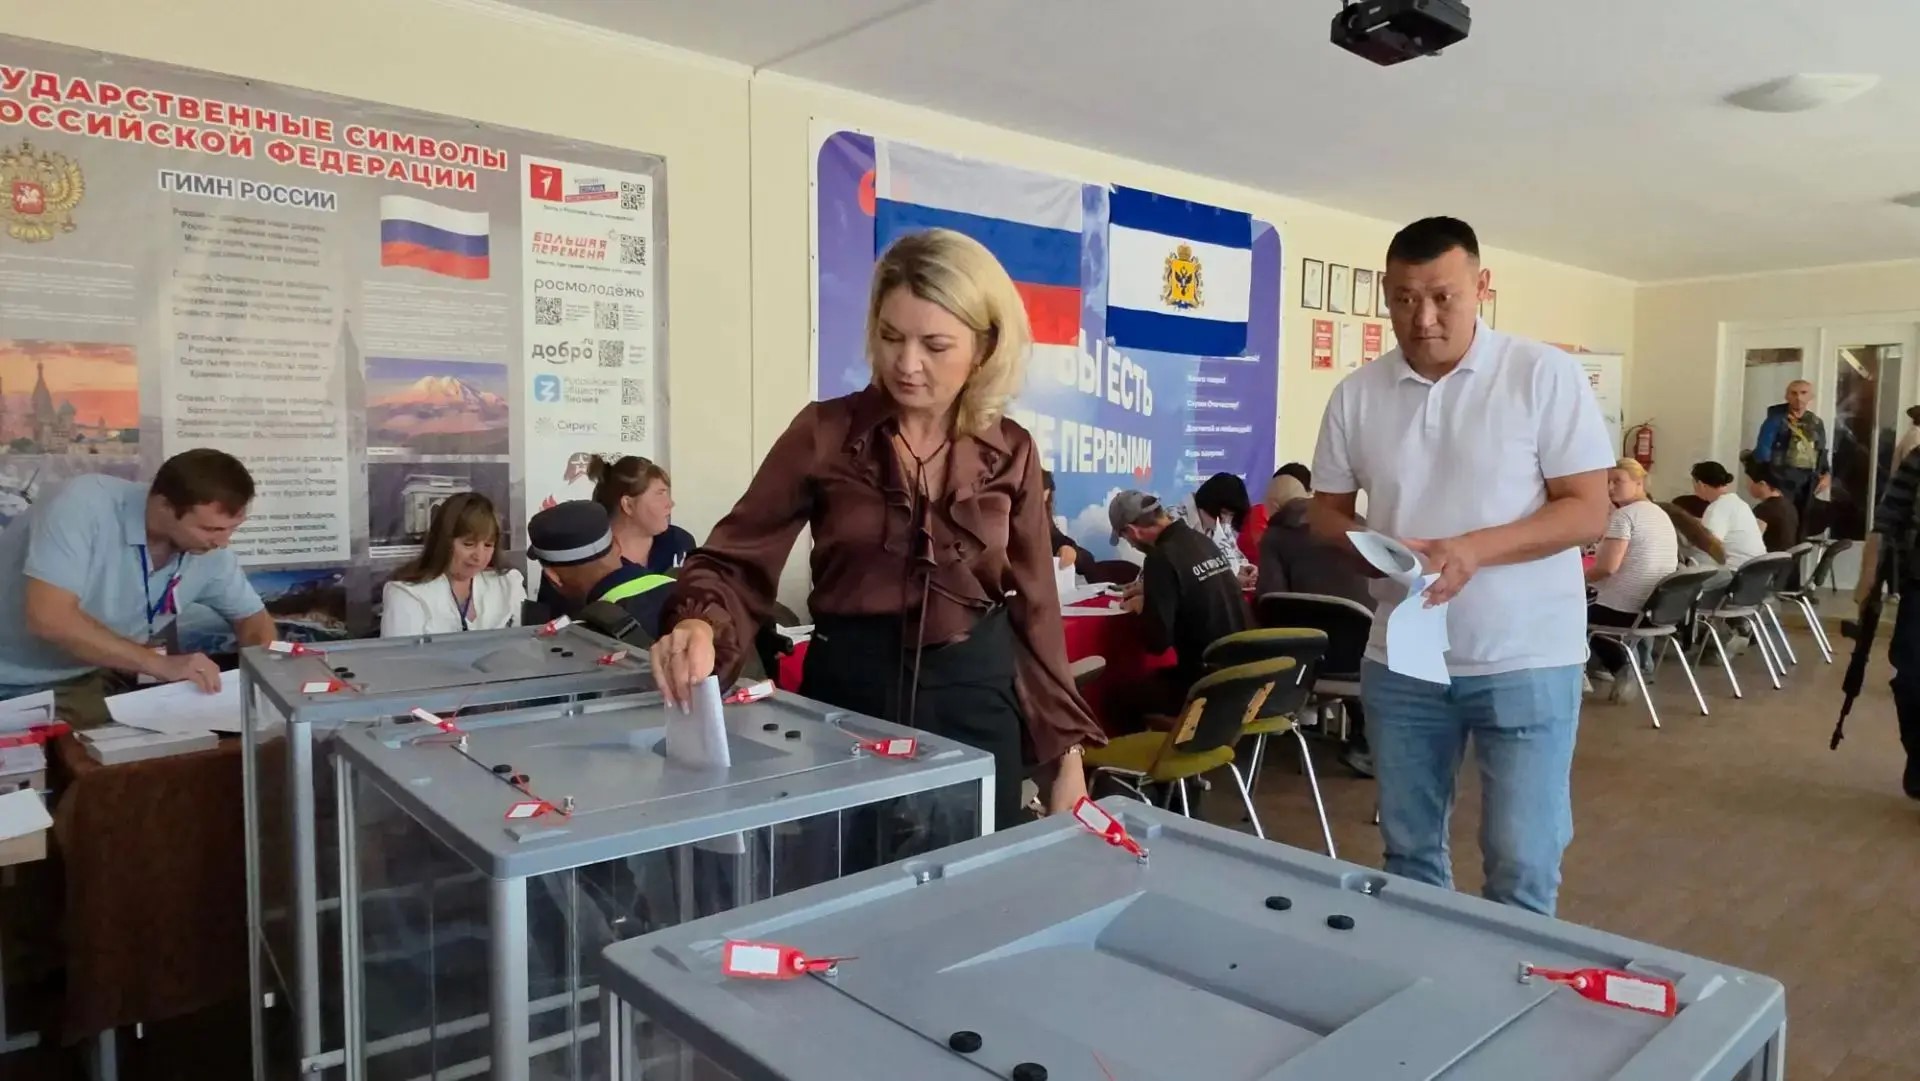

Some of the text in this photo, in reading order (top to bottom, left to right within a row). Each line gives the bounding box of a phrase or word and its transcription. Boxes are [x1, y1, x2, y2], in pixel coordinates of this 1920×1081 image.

[267, 140, 476, 190] ФЕДЕРАЦИИ
[345, 126, 507, 170] СИМВОЛЫ
[160, 171, 336, 210] ГИМН РОССИИ
[531, 243, 606, 261] ПЕРЕМЕНА
[533, 231, 608, 250] БОЛЬШАЯ
[531, 341, 593, 362] добро
[1108, 347, 1153, 417] ЕСТЬ
[557, 419, 599, 431] Сириус
[1060, 419, 1153, 475] ПЕРВЫМИ
